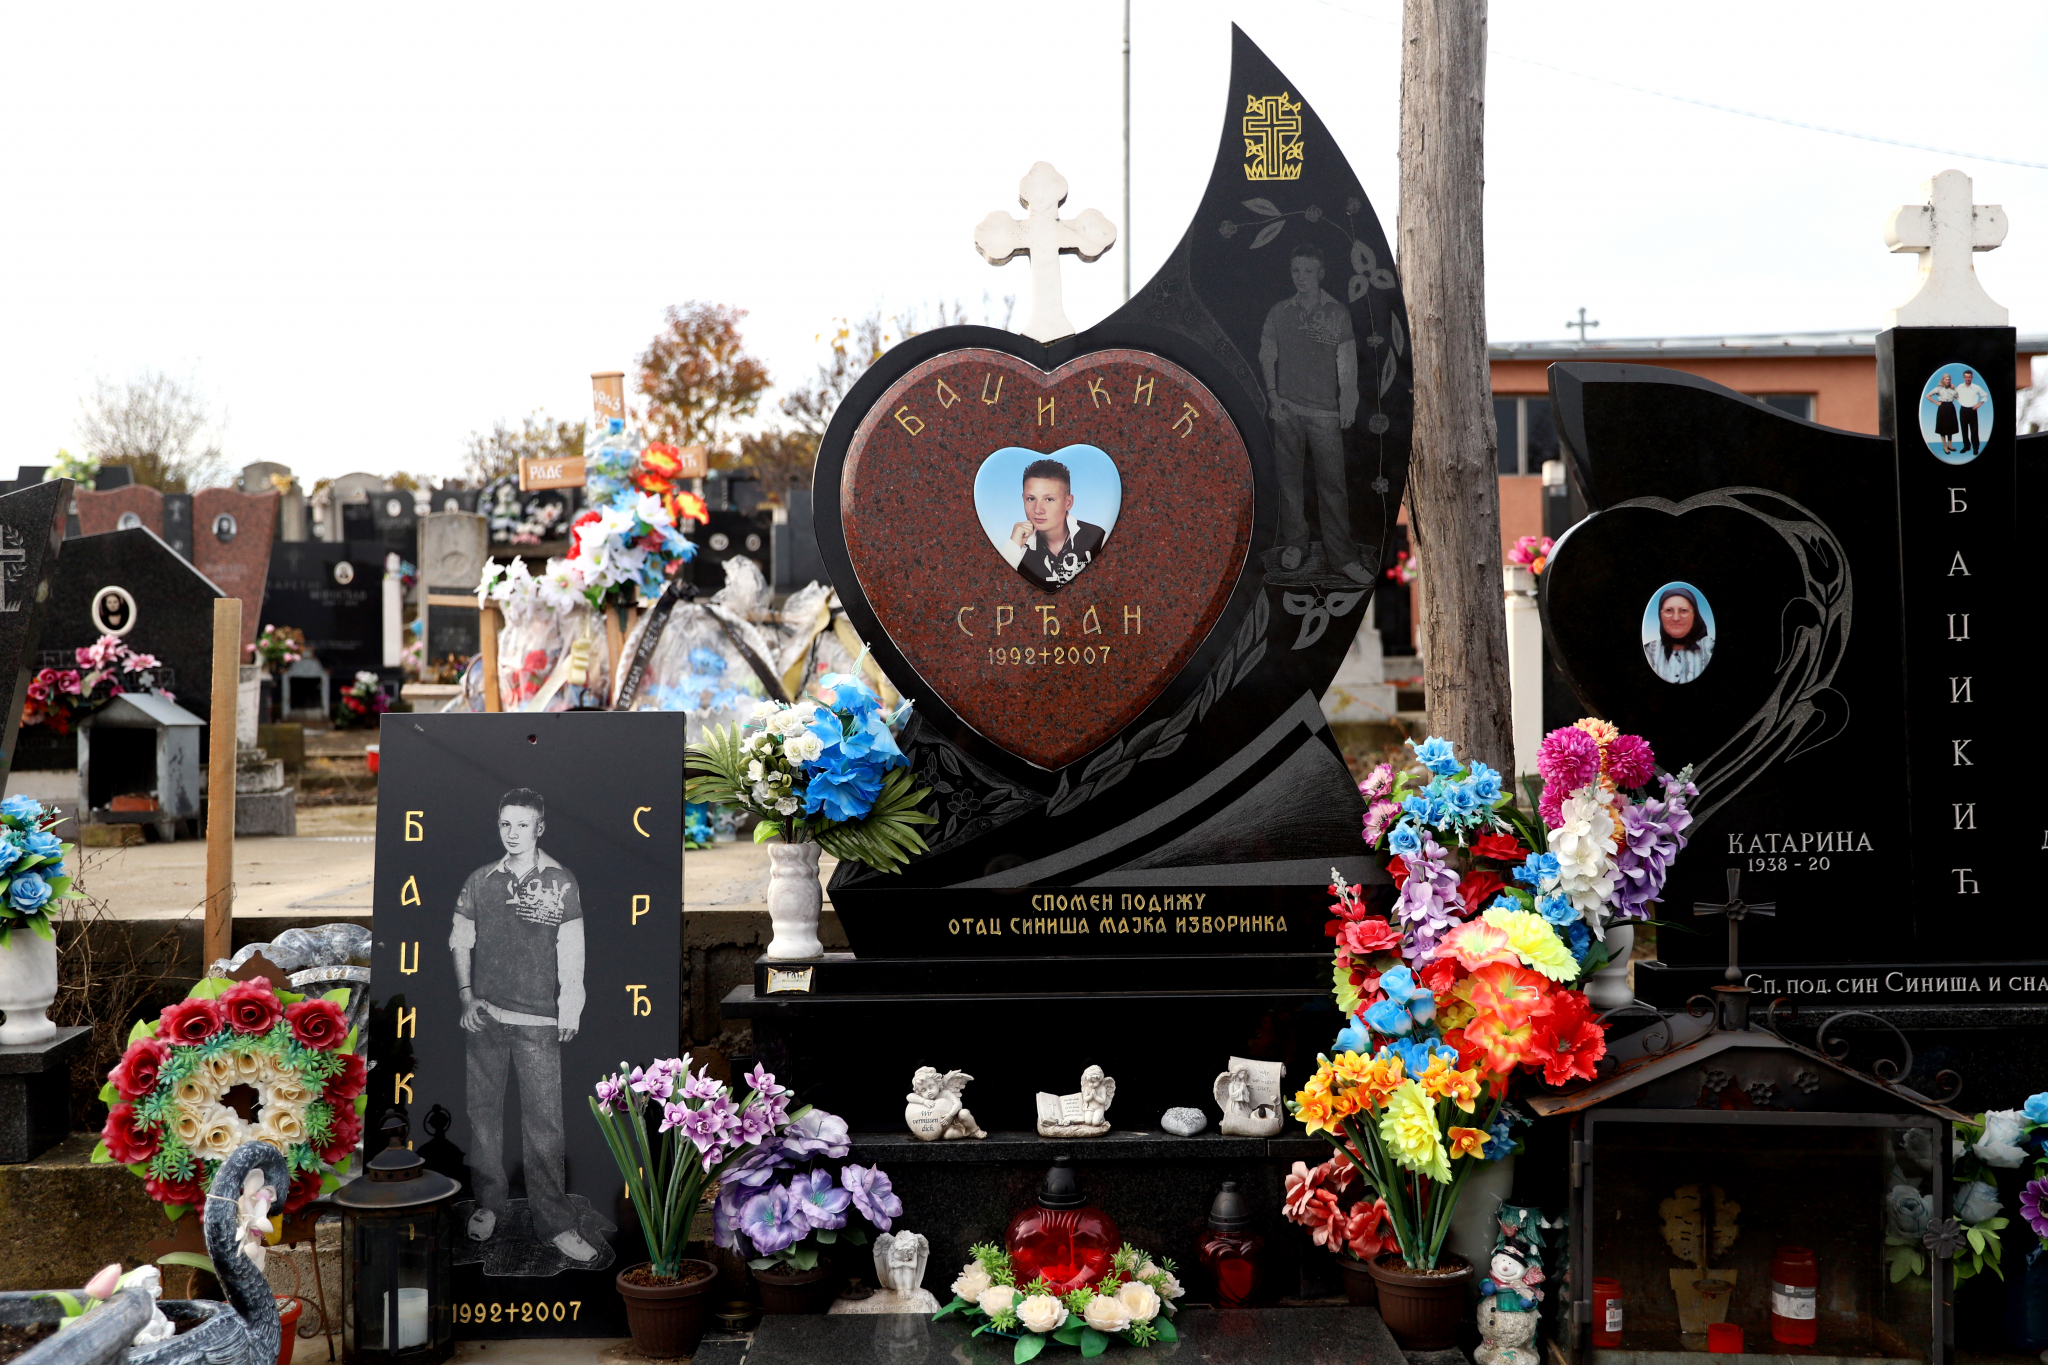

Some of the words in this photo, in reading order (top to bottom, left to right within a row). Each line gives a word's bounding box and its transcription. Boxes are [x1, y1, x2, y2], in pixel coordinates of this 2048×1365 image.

[957, 605, 1142, 636] СРЂАН
[1947, 487, 1981, 895] БАЏИКИЋ
[1728, 831, 1874, 854] КАТАРИНА
[1748, 858, 1788, 872] 1938
[1808, 857, 1830, 871] 20
[1032, 894, 1113, 912] СПОМЕН
[1121, 893, 1206, 912] ПОДИЖУ
[948, 918, 1002, 936] ОТАЦ
[1010, 917, 1090, 935] СИНИША
[1099, 916, 1168, 934] МАЈКА
[1176, 916, 1288, 934] ИЗВОРИНКА
